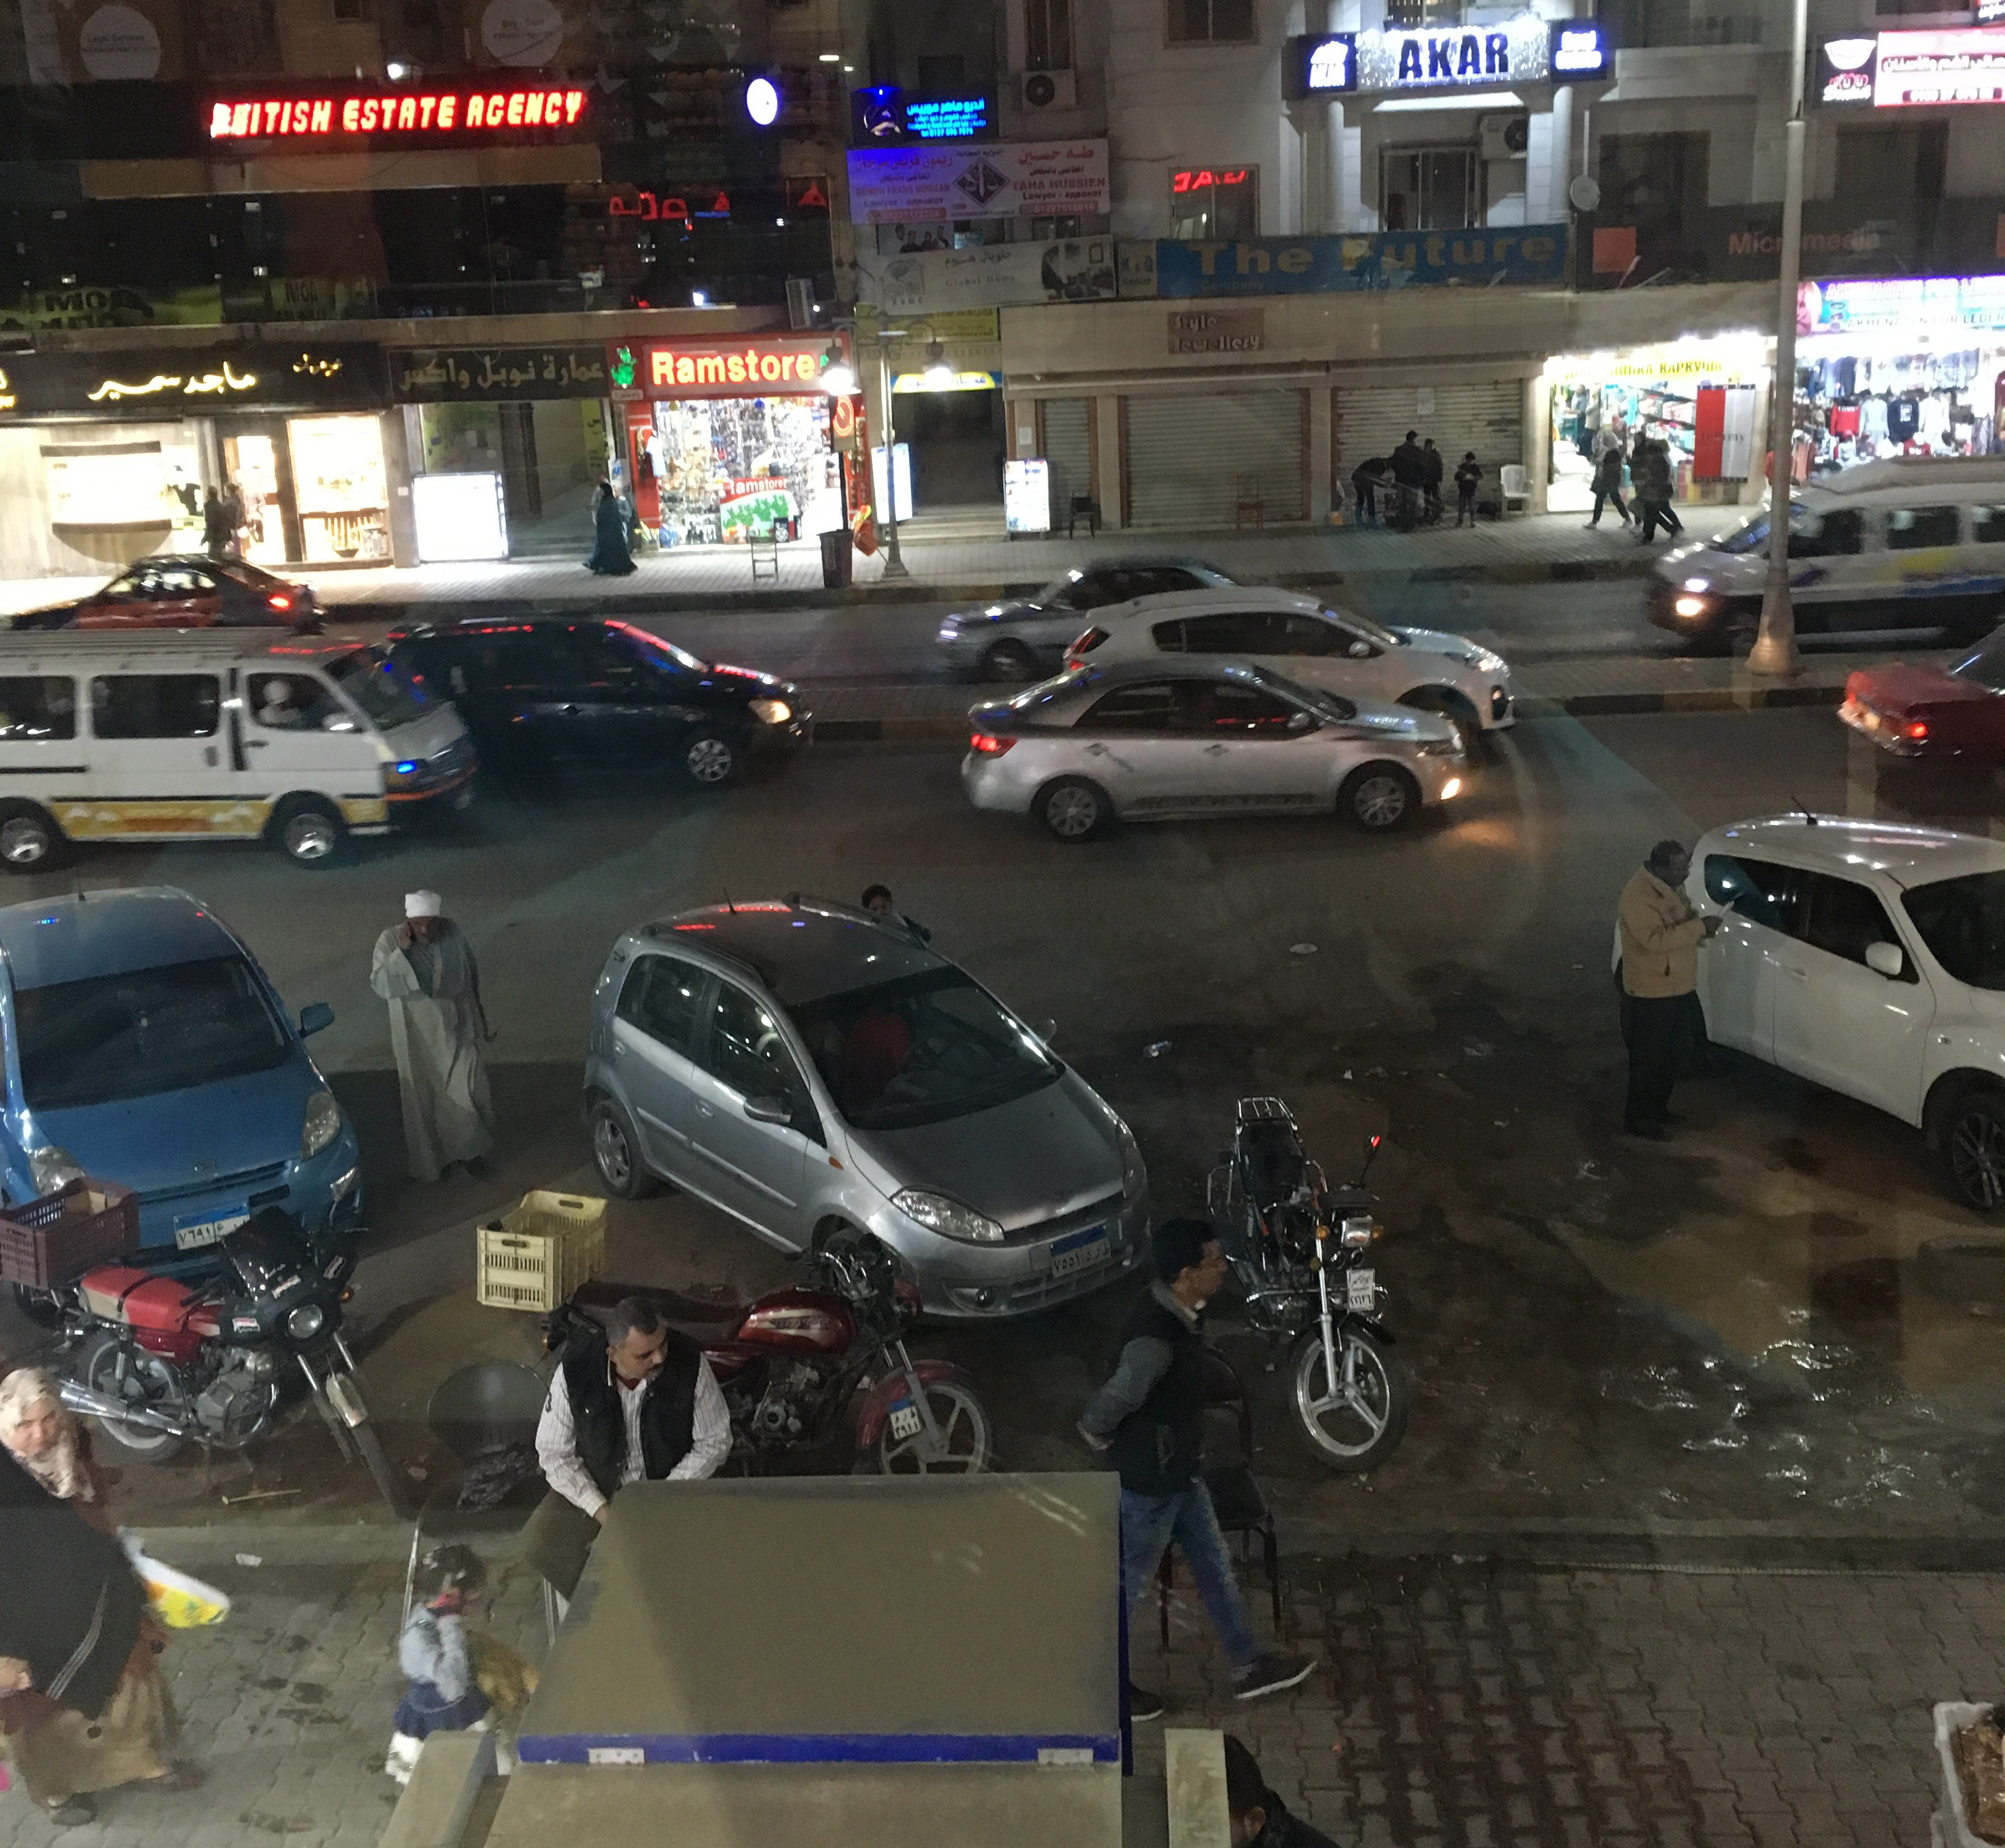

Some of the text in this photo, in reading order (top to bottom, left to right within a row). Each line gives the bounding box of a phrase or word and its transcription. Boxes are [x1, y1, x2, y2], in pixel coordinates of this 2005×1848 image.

[1398, 32, 1509, 80] AKAR
[210, 90, 583, 138] BRITISH ESTATE AGENCY
[1013, 177, 1106, 191] TAHA HUSSIEN
[1188, 234, 1558, 277] The Future
[88, 361, 257, 402] ماجد سمير
[477, 354, 536, 389] نوبل
[542, 353, 605, 387] عمارة
[651, 349, 816, 387] Ramstore
